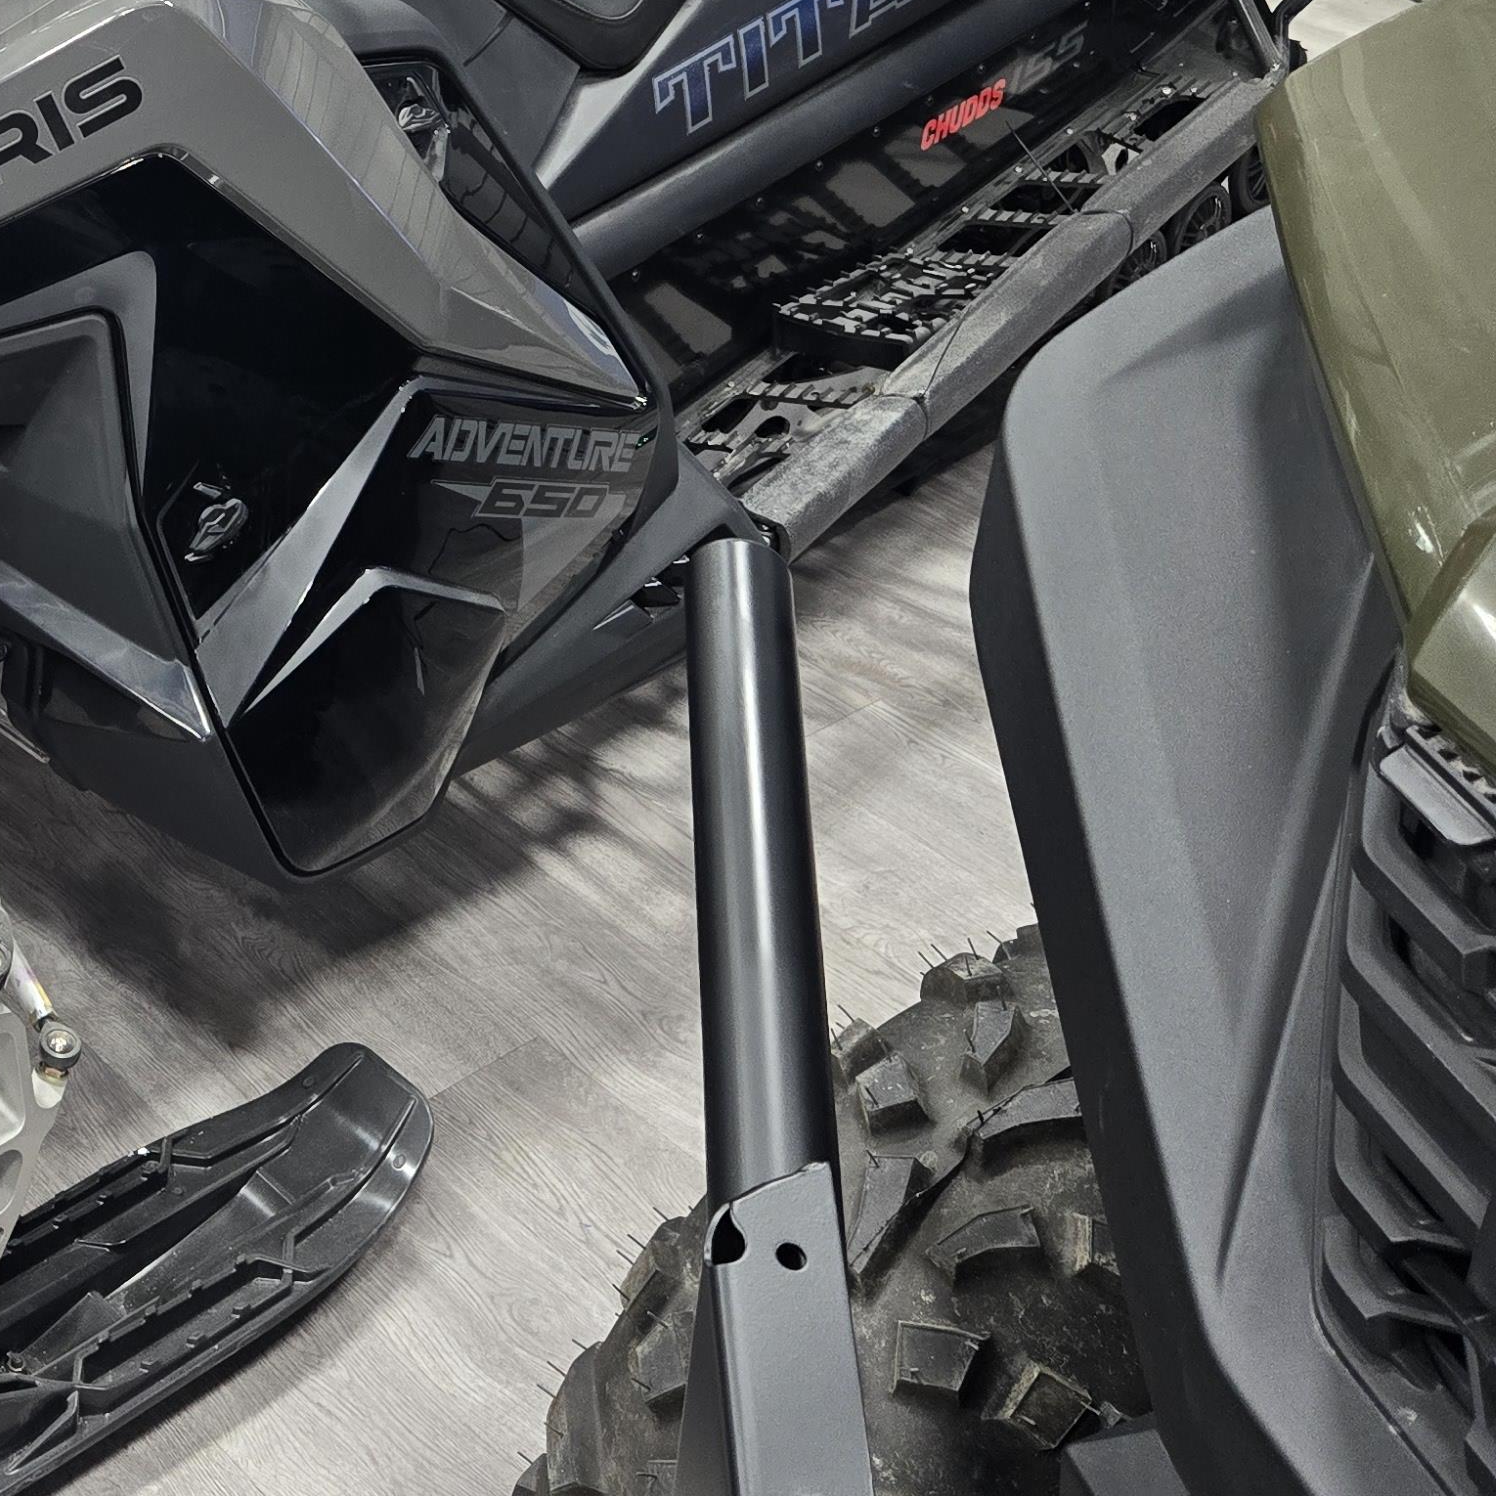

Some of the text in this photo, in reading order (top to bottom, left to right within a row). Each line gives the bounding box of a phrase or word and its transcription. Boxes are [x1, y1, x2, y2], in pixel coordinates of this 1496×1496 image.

[920, 77, 1006, 151] CHUDDS
[397, 414, 641, 473] ADVENTURE
[474, 478, 610, 518] 650
